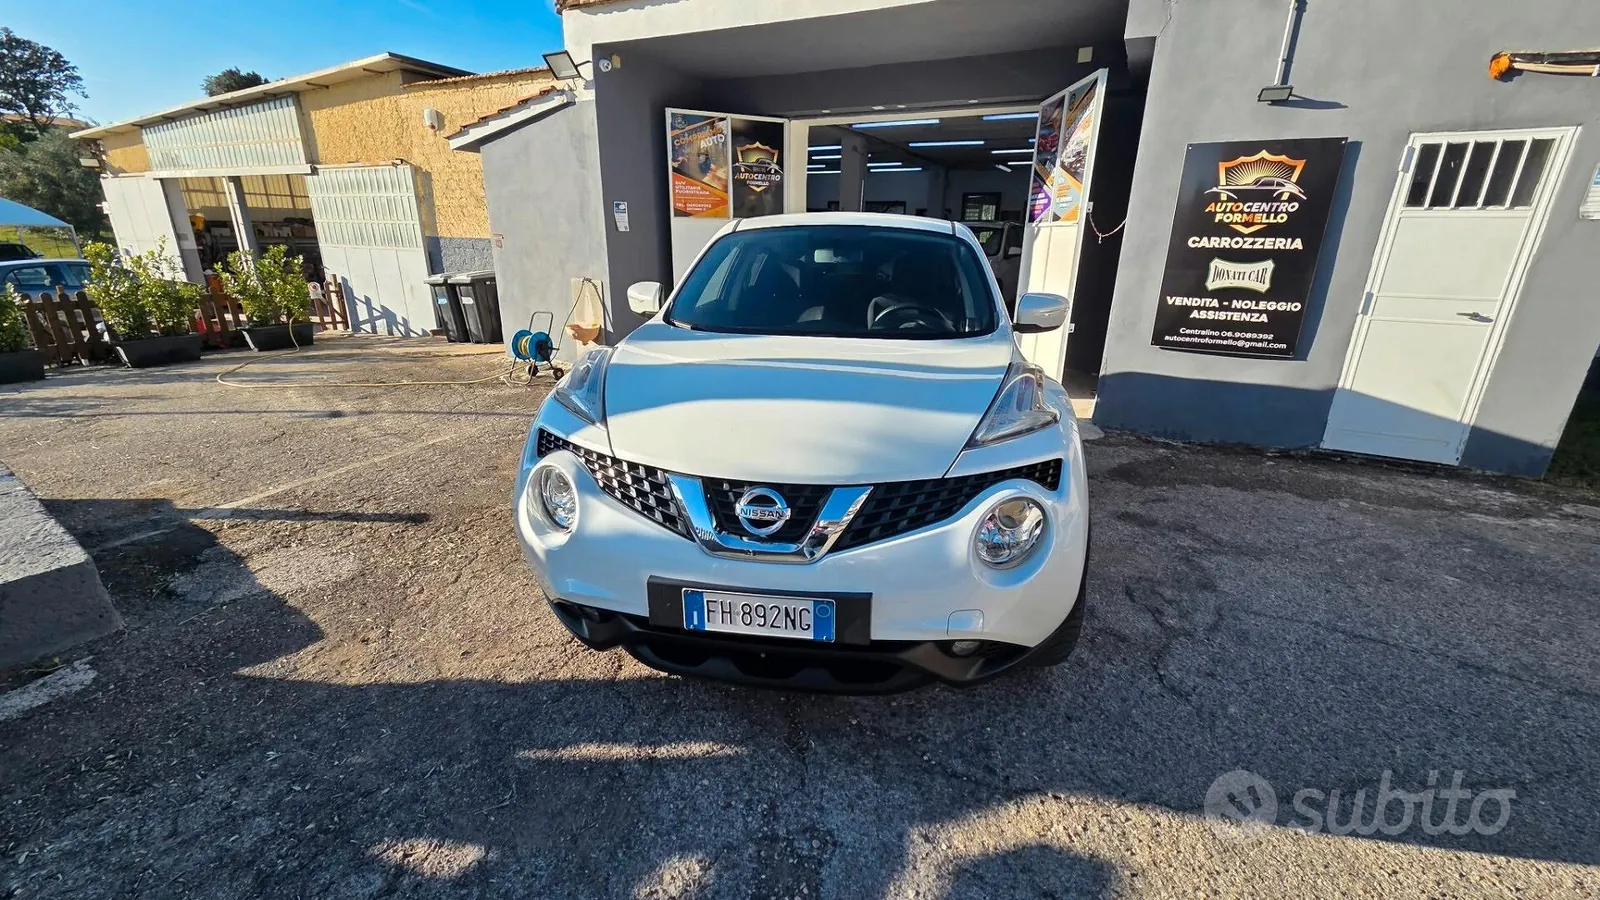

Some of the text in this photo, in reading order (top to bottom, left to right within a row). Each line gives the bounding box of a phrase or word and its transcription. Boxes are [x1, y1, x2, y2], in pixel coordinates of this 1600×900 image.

[700, 133, 725, 149] AUTO
[735, 172, 781, 181] AUTOCENTRO
[1205, 201, 1299, 213] AUTOCENTRO
[1214, 212, 1288, 224] FORMELLO
[1187, 236, 1304, 250] CARROZZERIA
[1211, 265, 1267, 284] DONATI CAR
[1166, 296, 1220, 308] VENDITA
[1231, 299, 1302, 312] NOLEGGIO
[1189, 310, 1269, 323] ASSISTENZA
[1179, 327, 1274, 340] Centralino 06.9089392
[1164, 334, 1287, 349] autocentroformello@gmail.com
[740, 508, 784, 519] NISSAN
[706, 599, 733, 625] FH
[741, 602, 811, 631] 892NG
